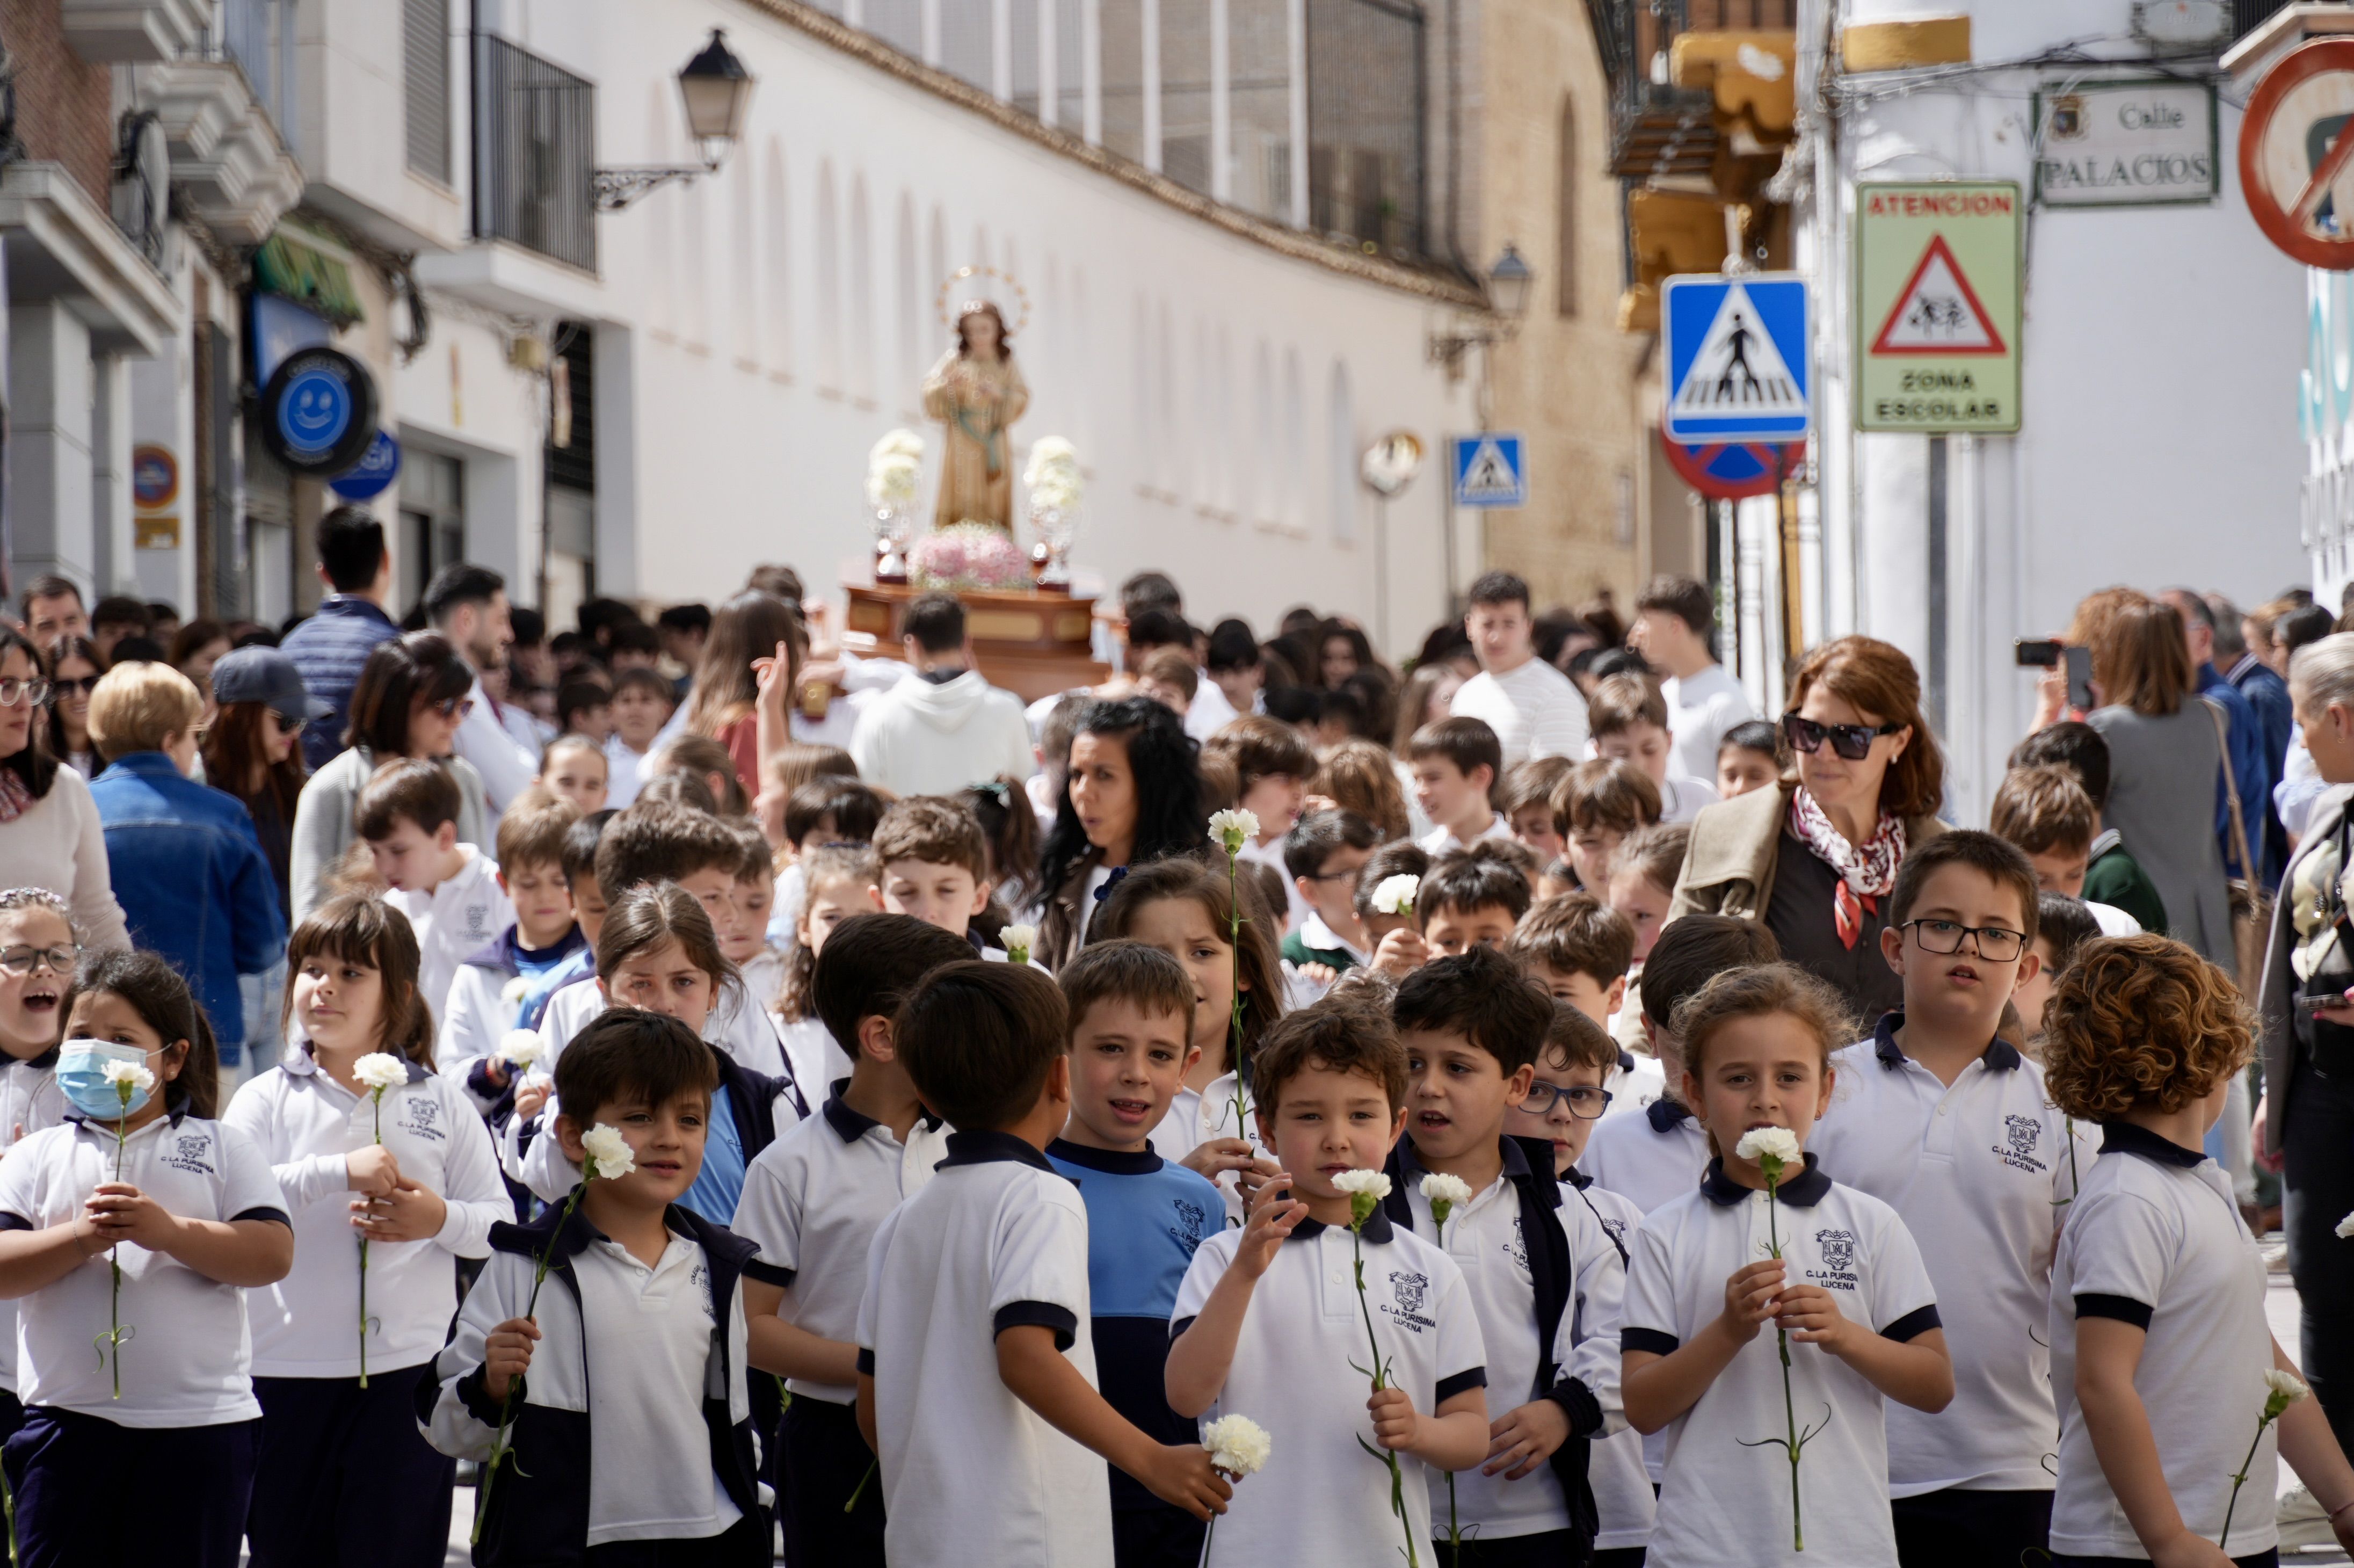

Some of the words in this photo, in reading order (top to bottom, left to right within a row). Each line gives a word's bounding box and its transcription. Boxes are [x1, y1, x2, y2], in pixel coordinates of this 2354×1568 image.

[2118, 102, 2184, 130] Calle
[2043, 152, 2211, 188] PALACIOS
[1868, 191, 2014, 217] ATENCION
[1898, 369, 1977, 393] ZONA
[1876, 398, 2002, 422] ESCOLAR
[172, 1163, 202, 1174] LUCENA
[2001, 1148, 2011, 1157] LA
[2014, 1152, 2047, 1171] PURISIMA
[2004, 1157, 2035, 1174] LUCENA
[1816, 1271, 1828, 1279] LA
[1821, 1280, 1855, 1291] LUCENA
[1390, 1306, 1400, 1316] LA
[1401, 1311, 1436, 1329] PURISIMA
[1394, 1316, 1421, 1334] LUCENA
